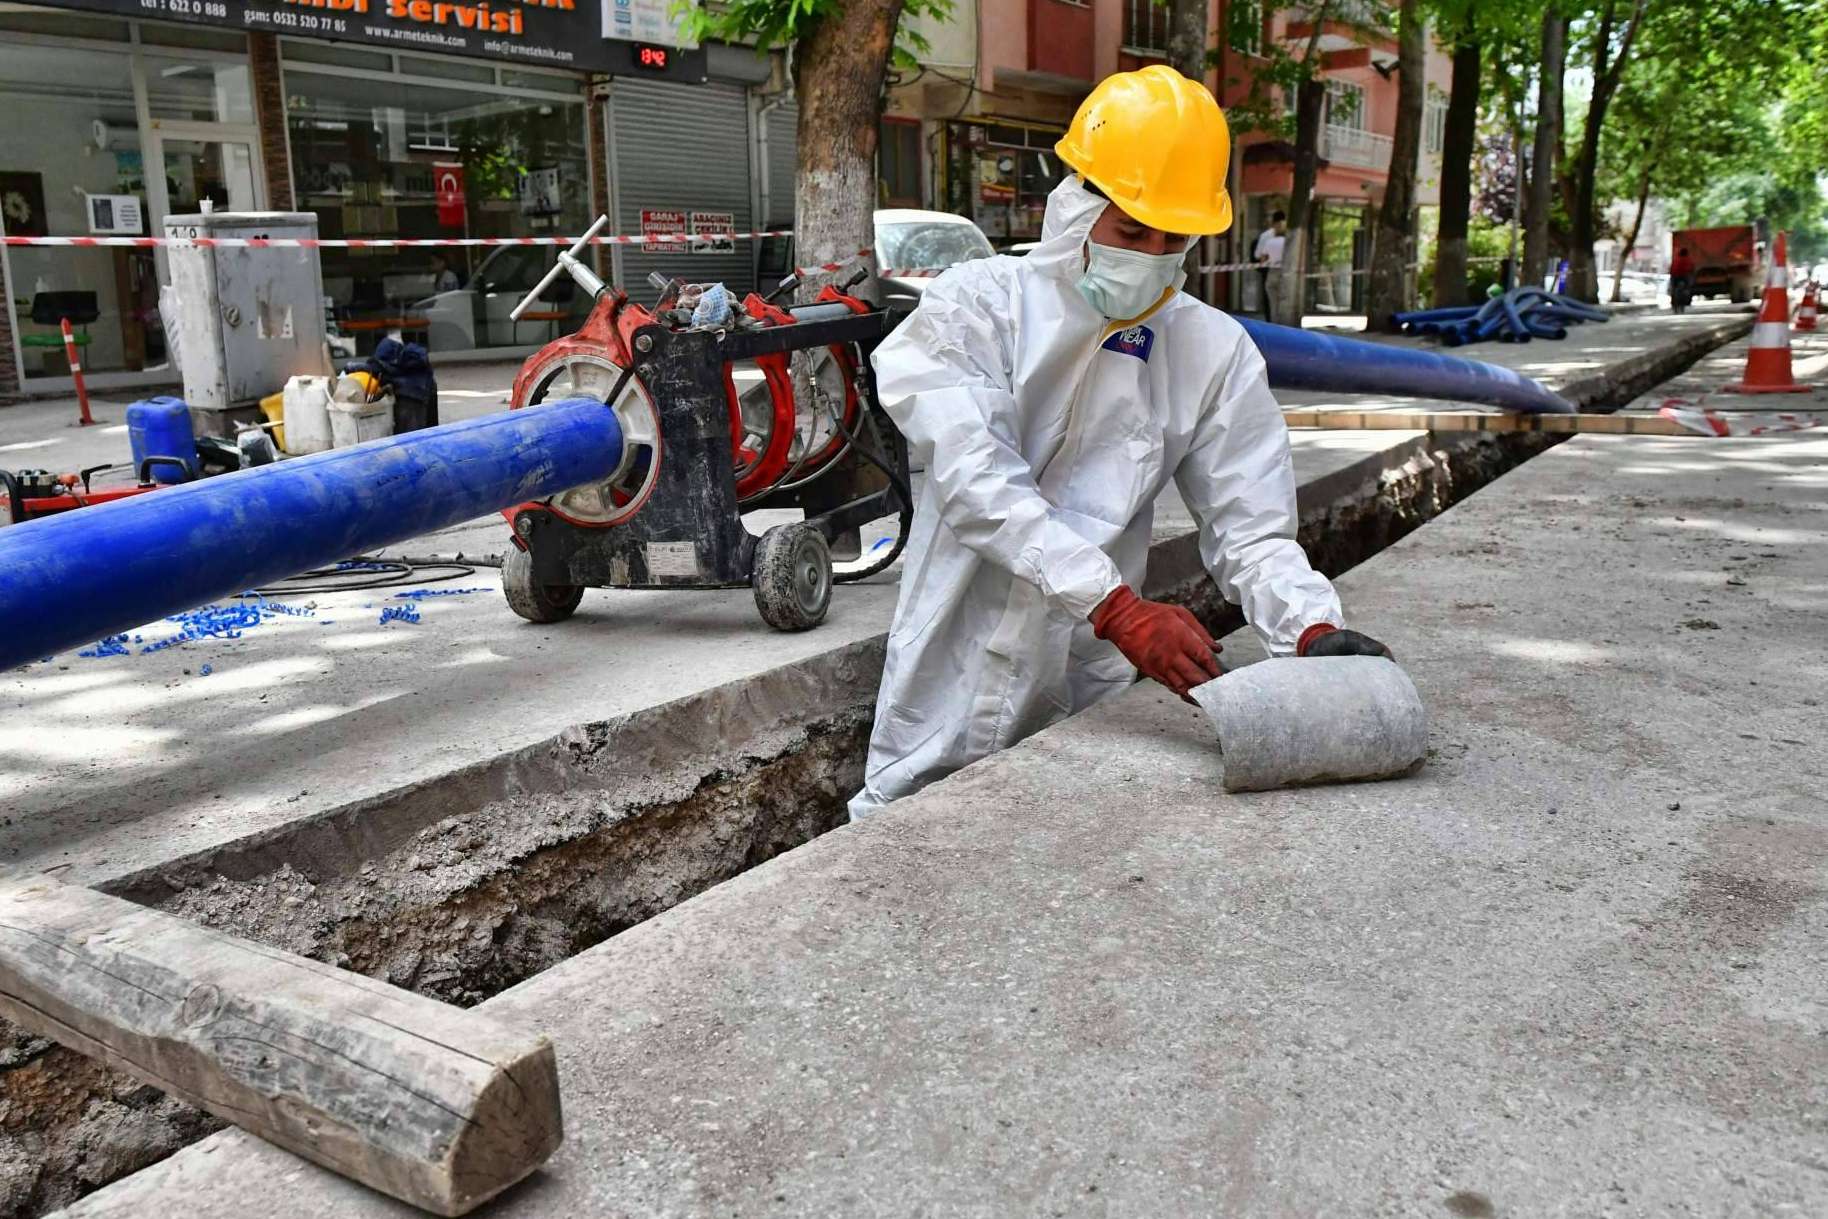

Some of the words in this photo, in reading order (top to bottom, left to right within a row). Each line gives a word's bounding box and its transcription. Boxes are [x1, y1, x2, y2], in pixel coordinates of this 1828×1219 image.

[169, 0, 190, 13] 622
[192, 1, 202, 14] 0
[204, 2, 227, 17] 888
[385, 0, 524, 34] servisi
[243, 10, 270, 24] gsm:
[273, 13, 297, 26] 0532
[299, 15, 318, 29] 520
[320, 17, 332, 31] 77
[333, 20, 346, 33] 85
[364, 25, 467, 48] www.armeteknik.com
[483, 39, 574, 62] info@armeteknik.com
[649, 212, 679, 221] GARAJ
